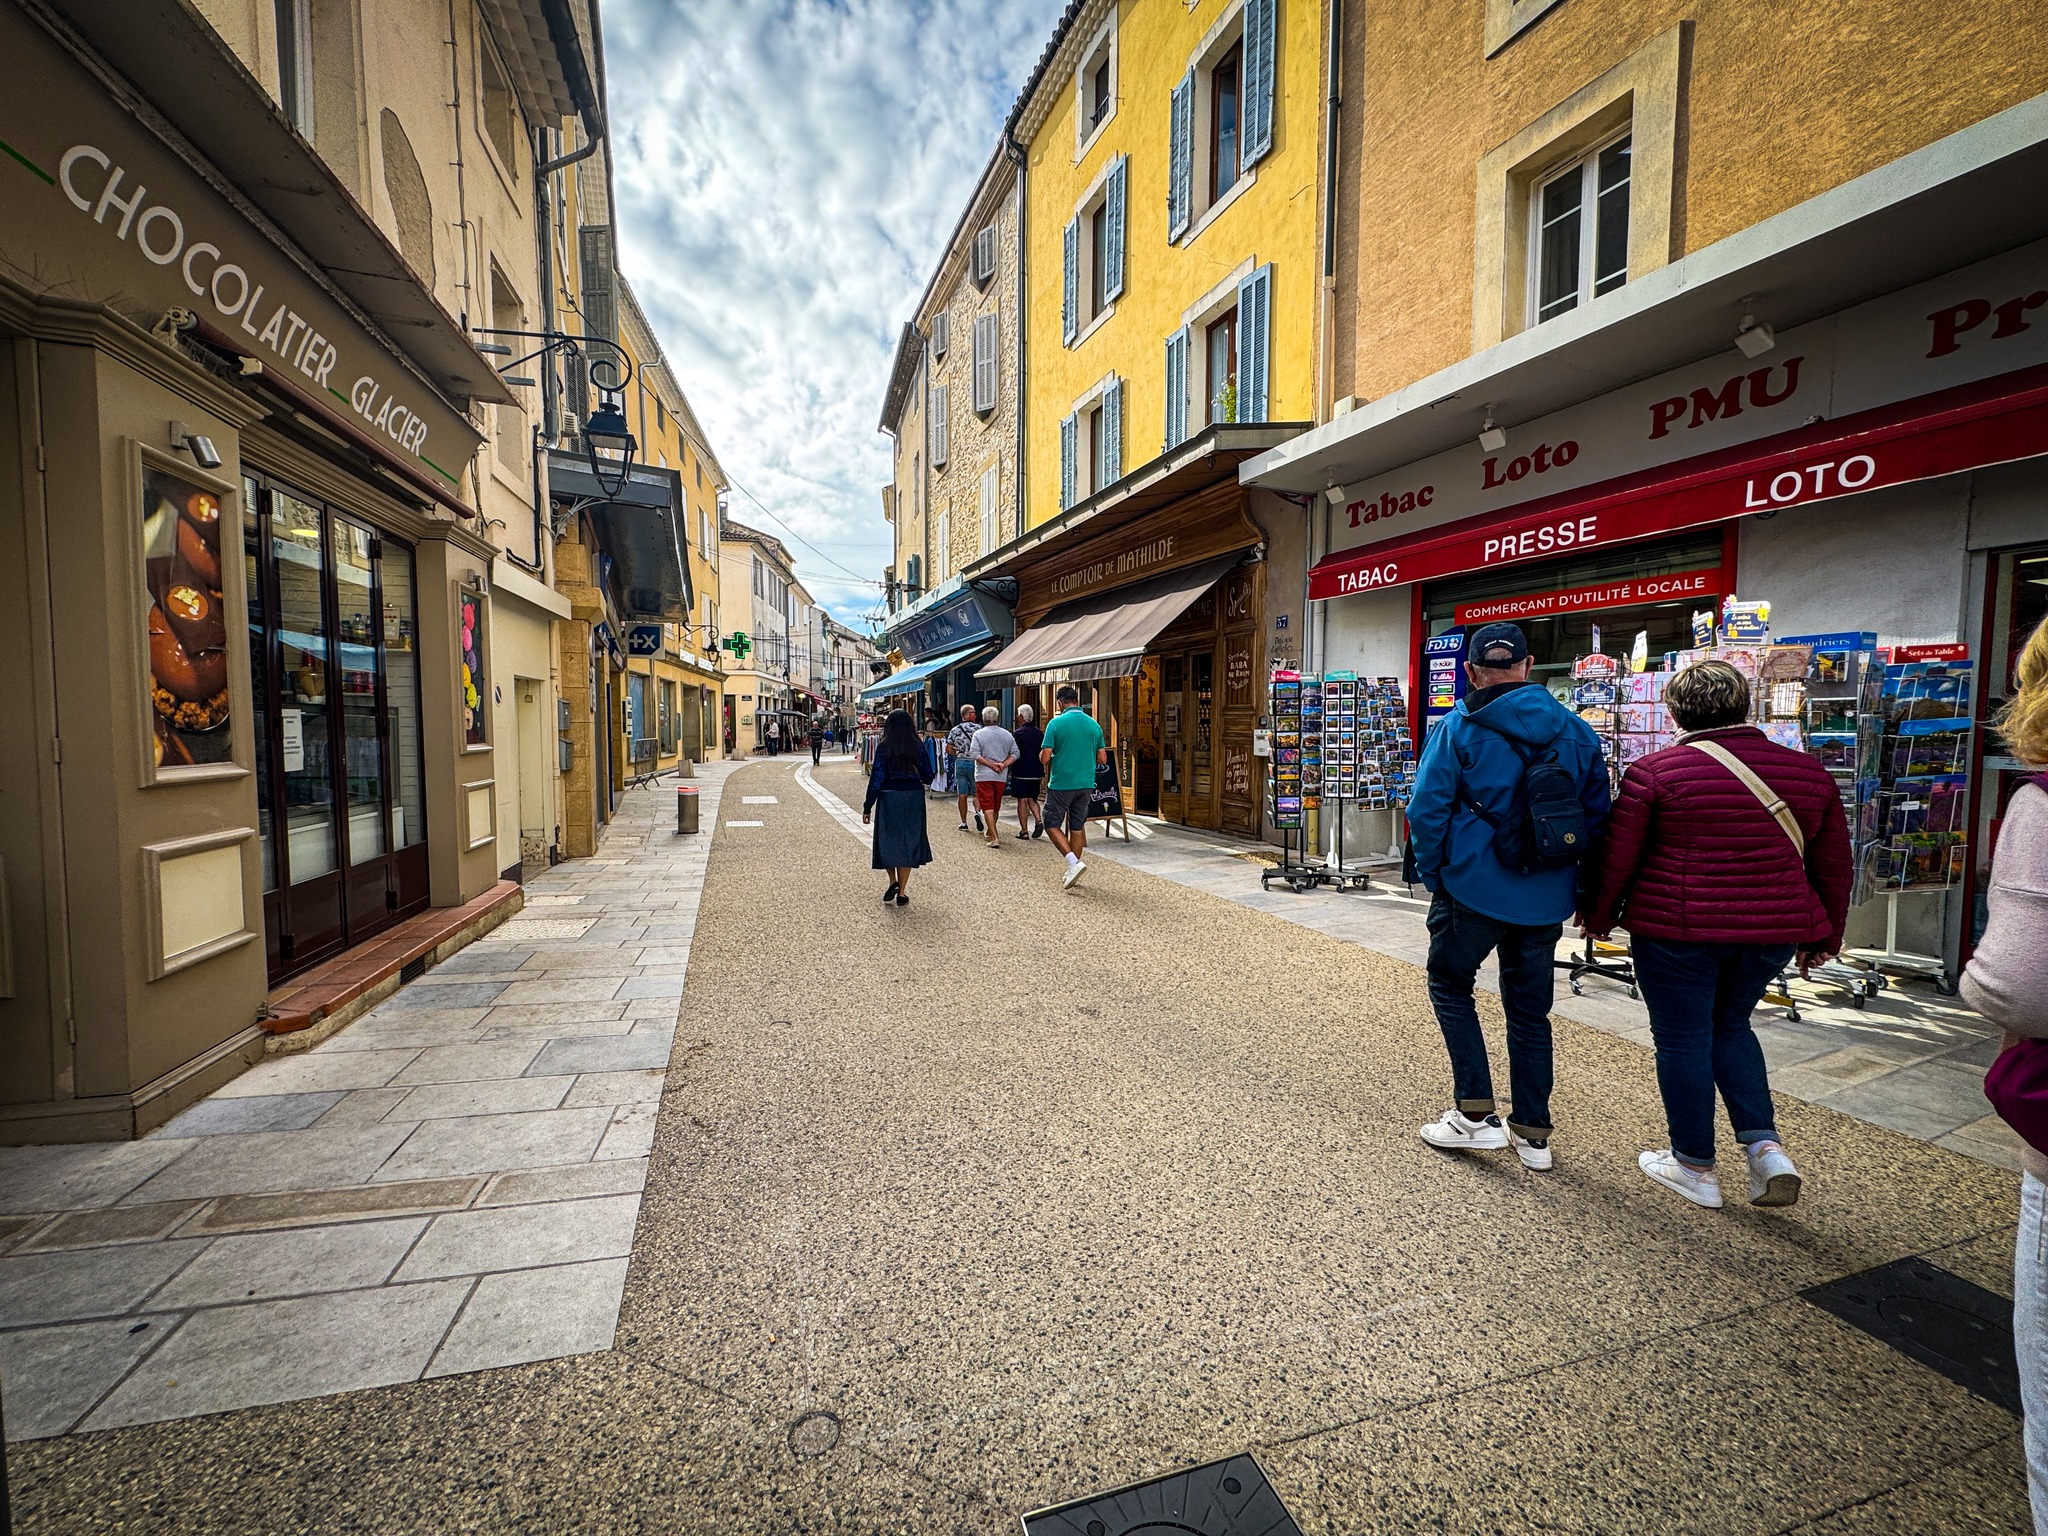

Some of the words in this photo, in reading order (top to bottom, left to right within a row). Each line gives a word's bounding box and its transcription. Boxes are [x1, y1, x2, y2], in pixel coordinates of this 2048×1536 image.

[59, 145, 338, 389] CHOCOLATIER
[351, 375, 428, 457] GLACIER
[1345, 484, 1435, 529] Tabac
[1481, 440, 1579, 490] Loto
[1648, 356, 1804, 440] PMU
[1337, 563, 1398, 592] TABAC
[1484, 516, 1598, 562] PRESSE
[1745, 455, 1875, 508] LOTO
[1051, 582, 1059, 594] LE
[1059, 562, 1103, 593] COMPTOIR
[1105, 560, 1114, 575] DE
[1117, 536, 1174, 574] MATHILDE
[1465, 597, 1555, 619] COMMERÇANT
[1558, 584, 1631, 606] D'UTILITÉ
[1637, 576, 1705, 596] LOCALE
[1277, 616, 1287, 627] 57
[1427, 639, 1448, 651] FDJ
[1783, 637, 1850, 647] Clendriers
[1908, 649, 1925, 657] Sets
[1934, 648, 1955, 656] Table
[1230, 661, 1248, 669] BABA
[1045, 667, 1070, 683] MATHILDE
